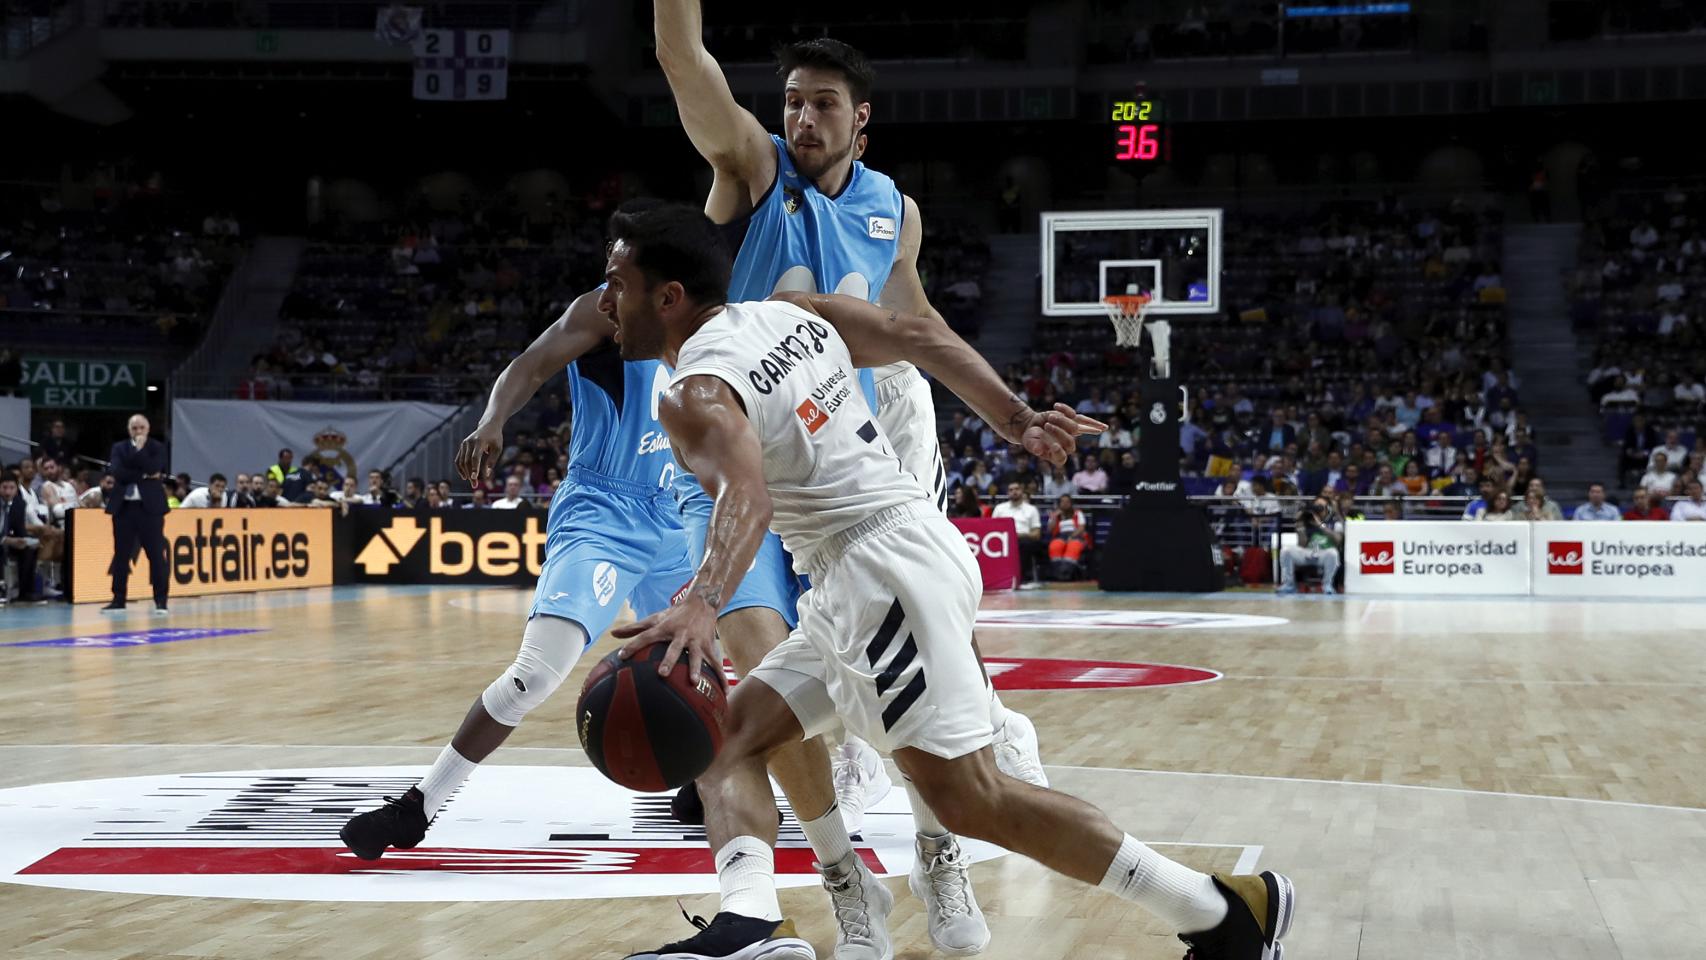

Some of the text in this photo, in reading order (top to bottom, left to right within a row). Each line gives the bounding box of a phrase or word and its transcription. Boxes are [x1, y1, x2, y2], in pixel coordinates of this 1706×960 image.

[425, 33, 492, 54] 2 0
[426, 74, 492, 95] 0 9
[1116, 125, 1158, 159] 3.6
[44, 387, 101, 406] EXIT
[1403, 541, 1517, 556] Universidad
[1403, 560, 1483, 577] Europea
[1591, 560, 1675, 578] Europea
